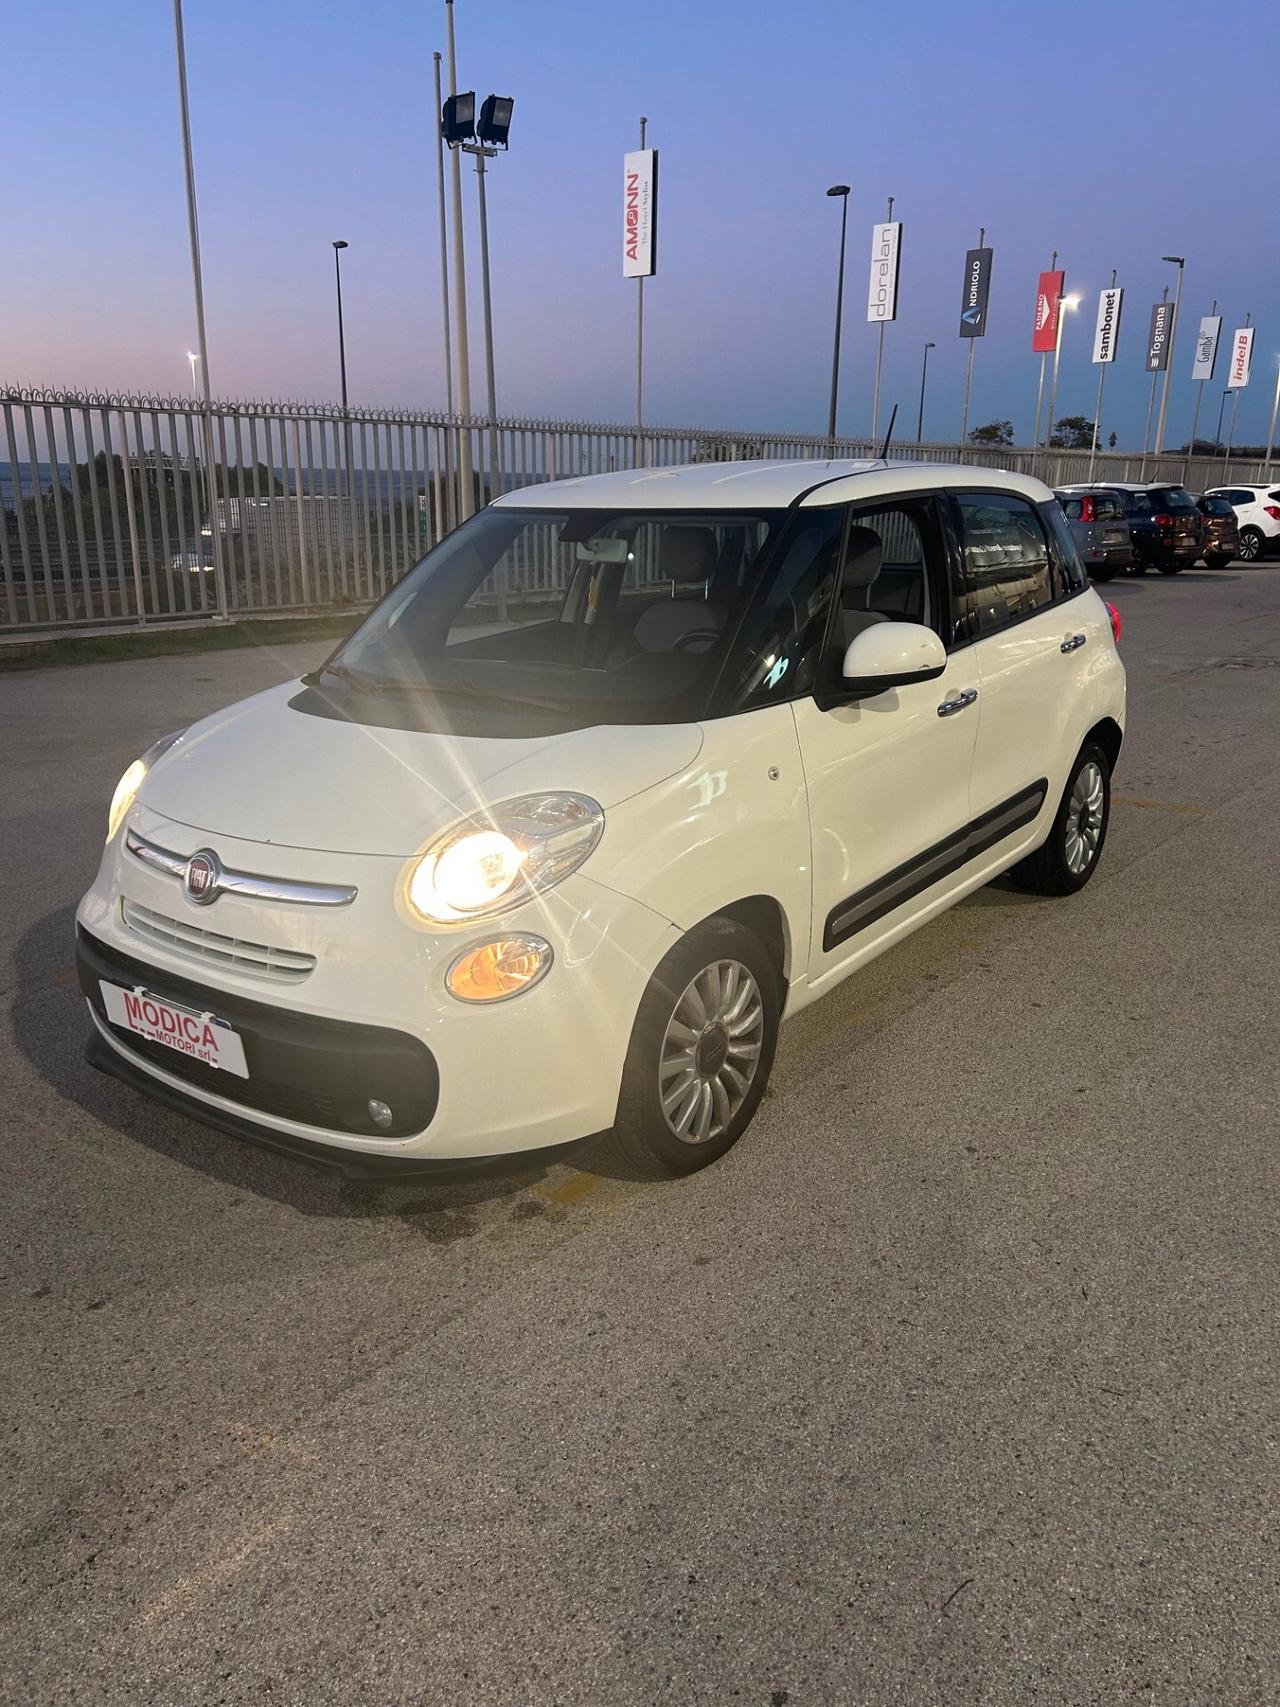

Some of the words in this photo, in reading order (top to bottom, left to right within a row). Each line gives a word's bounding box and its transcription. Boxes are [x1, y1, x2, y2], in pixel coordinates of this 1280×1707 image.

[626, 173, 639, 260] AMONN
[870, 228, 891, 317] dorelan
[1035, 294, 1044, 331] PADERNO
[1100, 292, 1115, 360] sambonet
[1150, 306, 1165, 357] Tognana
[1197, 336, 1213, 363] Gamba
[191, 867, 207, 888] FIAT
[123, 991, 219, 1052] MODICA
[155, 1029, 195, 1055] MOTORI
[198, 1049, 211, 1061] srl
